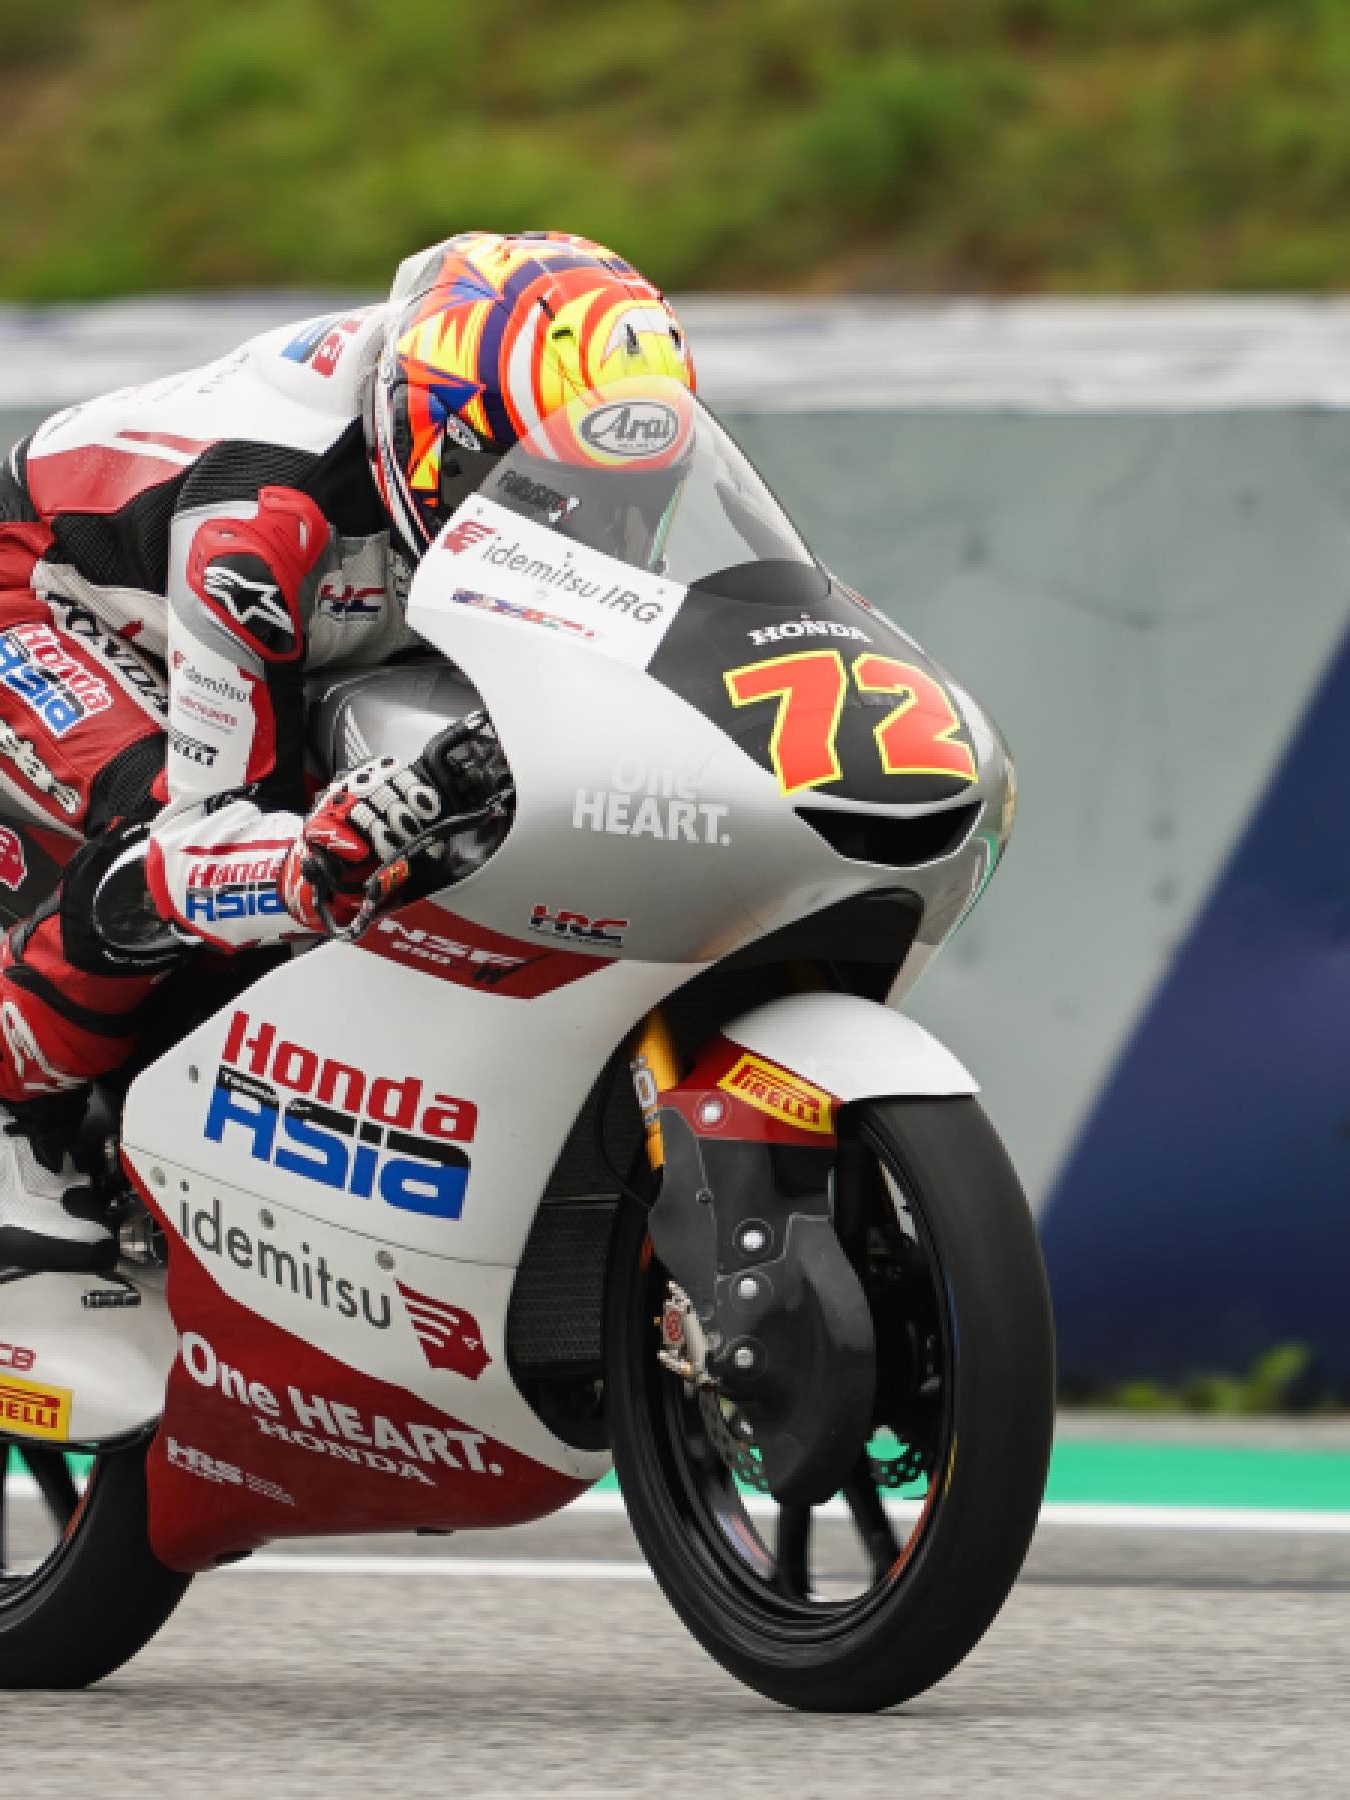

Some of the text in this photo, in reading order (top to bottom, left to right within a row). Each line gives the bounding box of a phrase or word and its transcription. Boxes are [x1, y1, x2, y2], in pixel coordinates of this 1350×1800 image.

[483, 536, 664, 624] idemitsu IRG
[15, 623, 111, 711] Honda
[747, 620, 873, 645] HONDA
[723, 650, 978, 796] 72
[572, 787, 732, 846] HEART.
[530, 904, 629, 944] HRC
[221, 1010, 478, 1143] Honda
[730, 1064, 820, 1125] PIRELLI
[179, 1180, 391, 1329] idemitsu
[181, 1331, 504, 1476] One HEART.
[252, 1416, 437, 1487] HONDA
